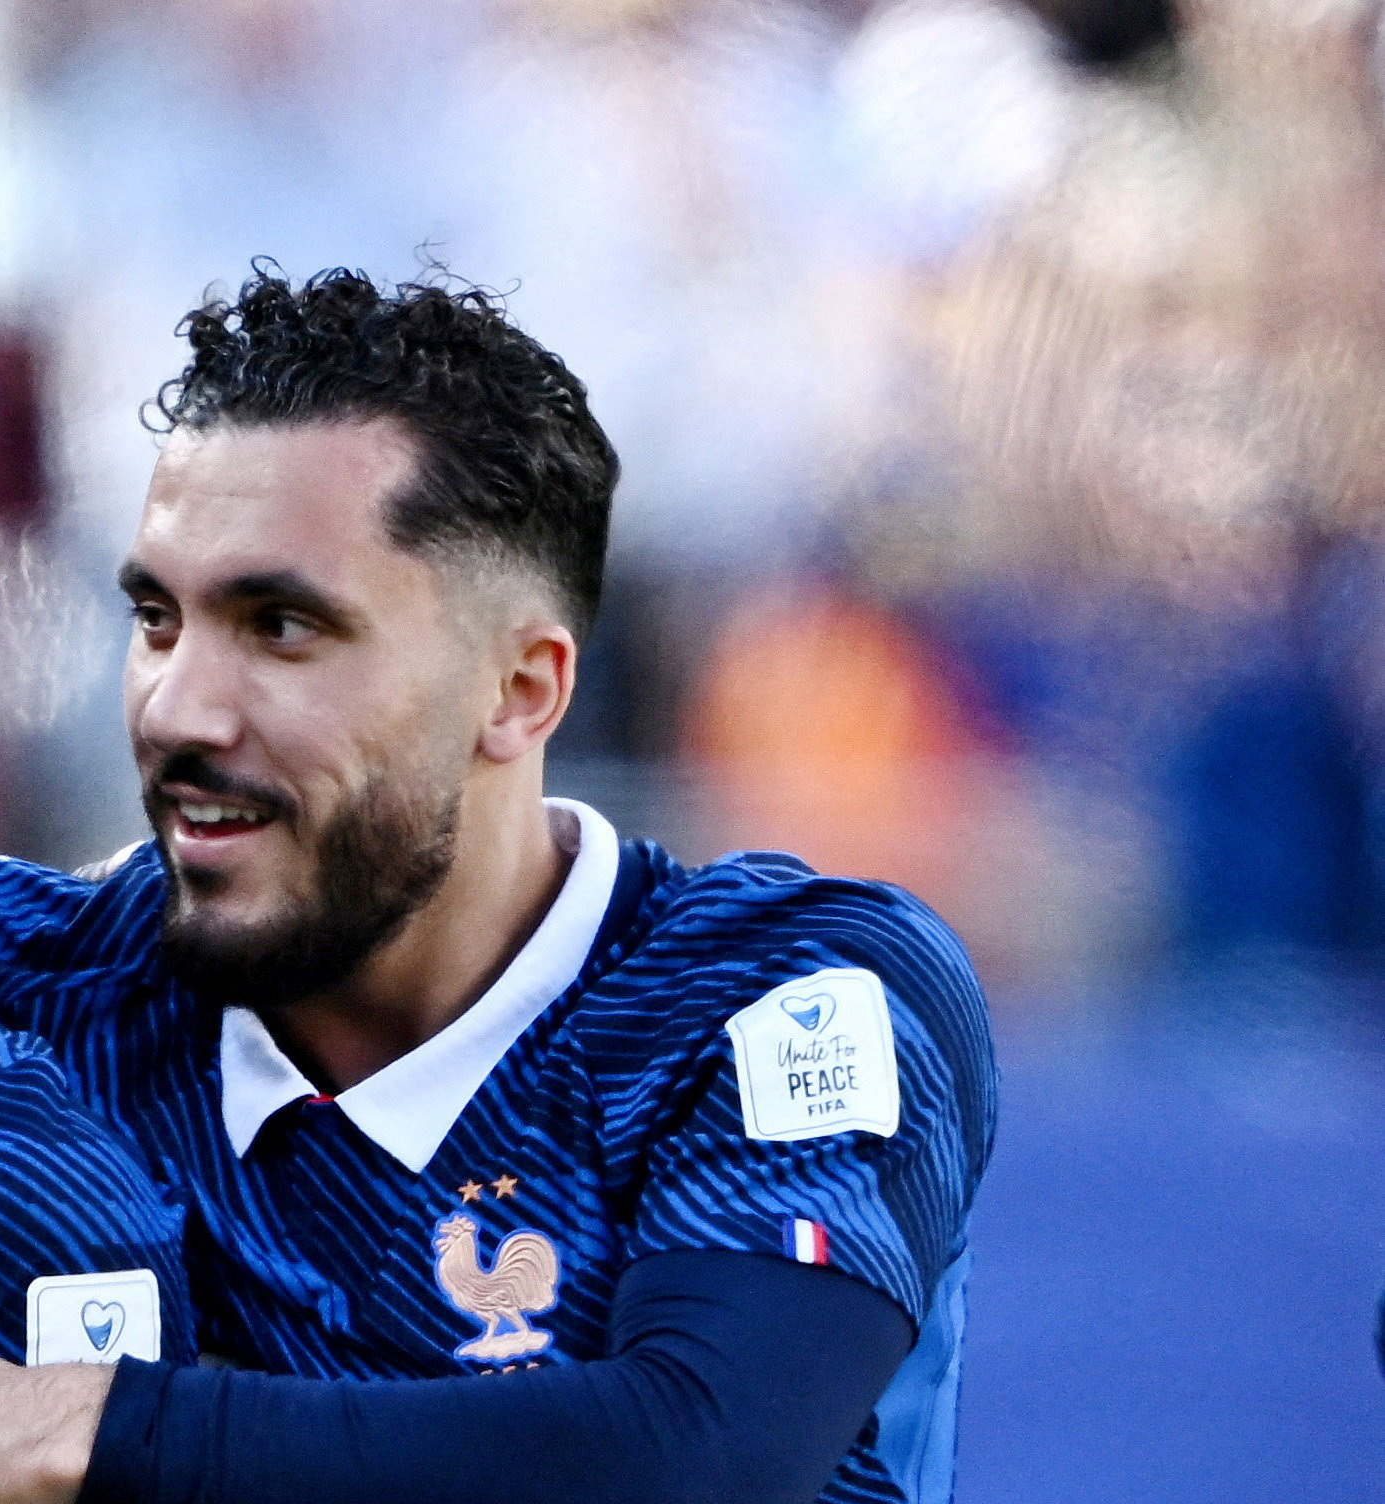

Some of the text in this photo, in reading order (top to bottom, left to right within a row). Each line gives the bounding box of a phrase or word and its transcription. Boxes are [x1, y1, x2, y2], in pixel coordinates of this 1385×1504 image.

[778, 1034, 857, 1070] Unite For
[787, 1065, 860, 1100] PEACE
[807, 1098, 847, 1117] FIFA
